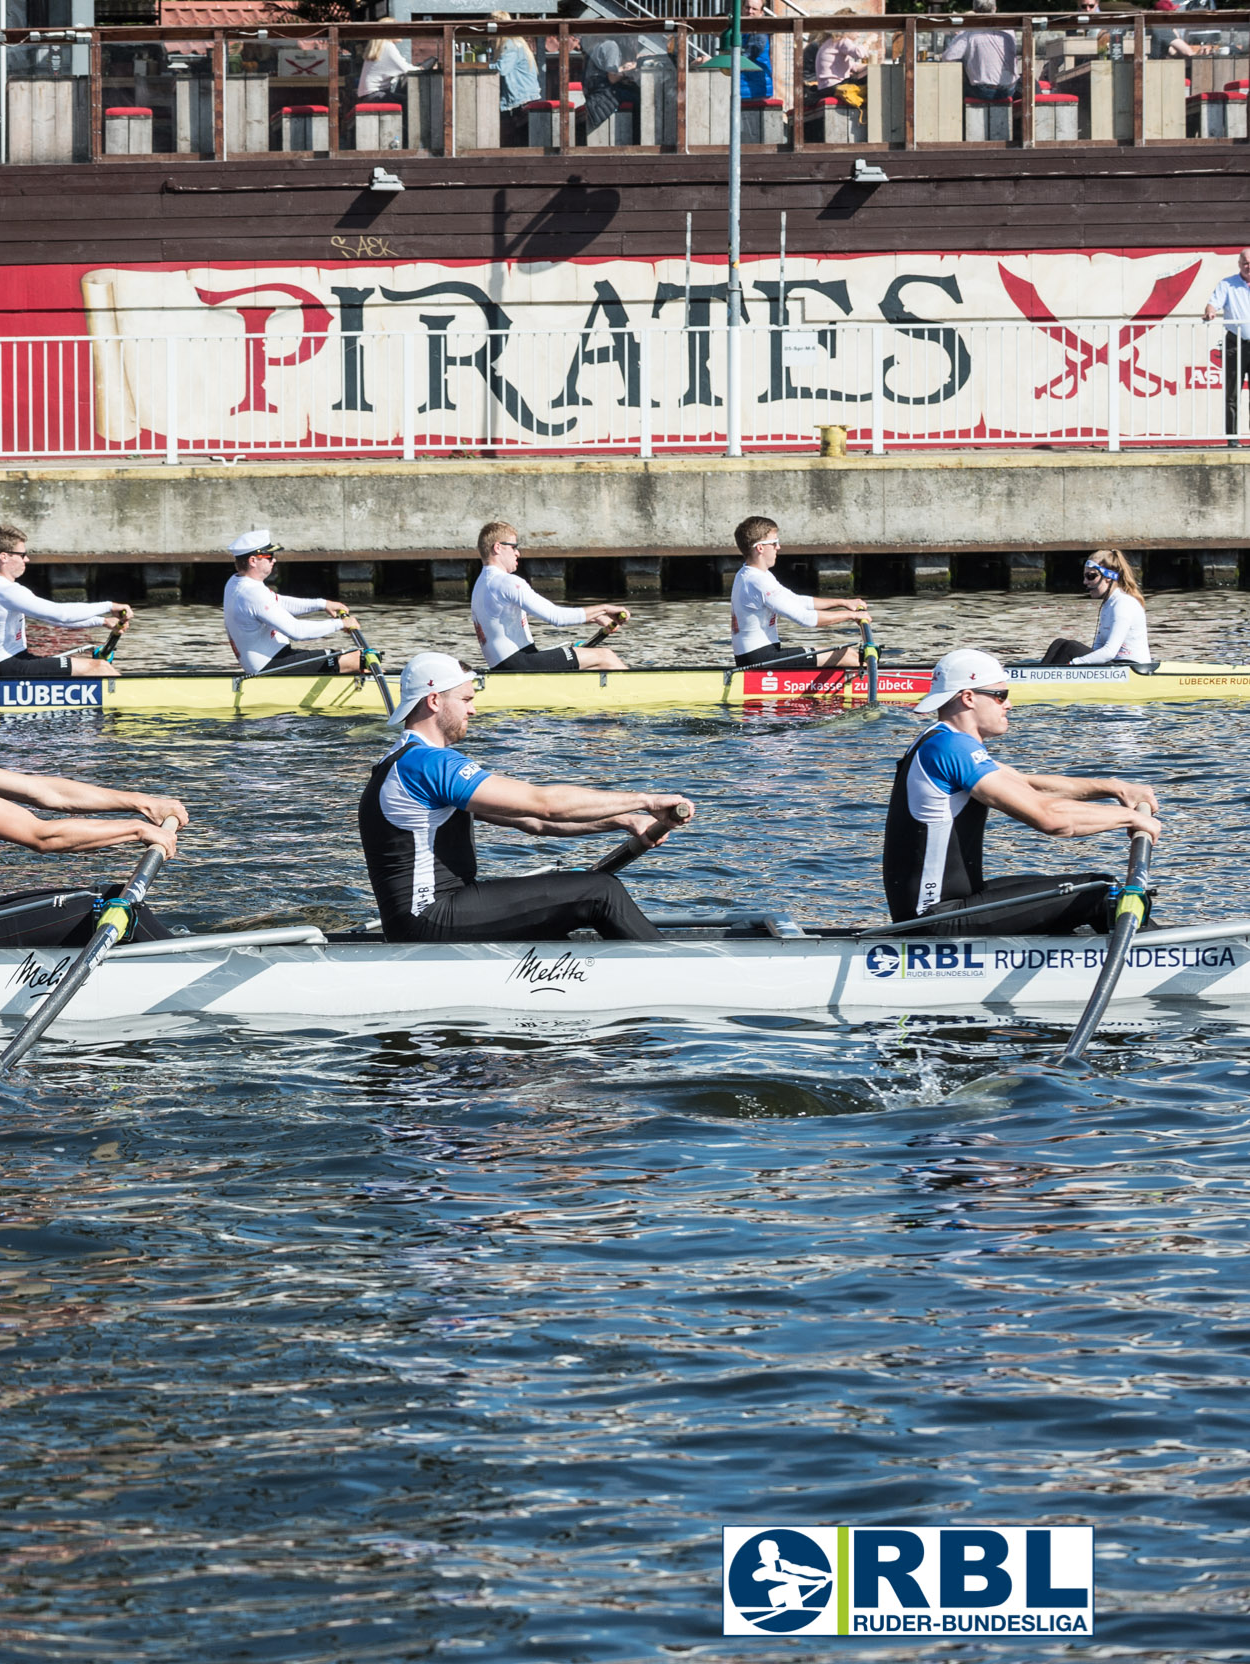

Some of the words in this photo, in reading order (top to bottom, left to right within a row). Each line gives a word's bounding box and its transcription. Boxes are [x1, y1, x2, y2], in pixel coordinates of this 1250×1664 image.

[194, 273, 973, 437] PIRATES
[3, 681, 98, 705] LÜBECK
[784, 680, 843, 693] Sparkasse
[1179, 677, 1227, 685] LÜBECKER
[907, 943, 984, 969] RBL
